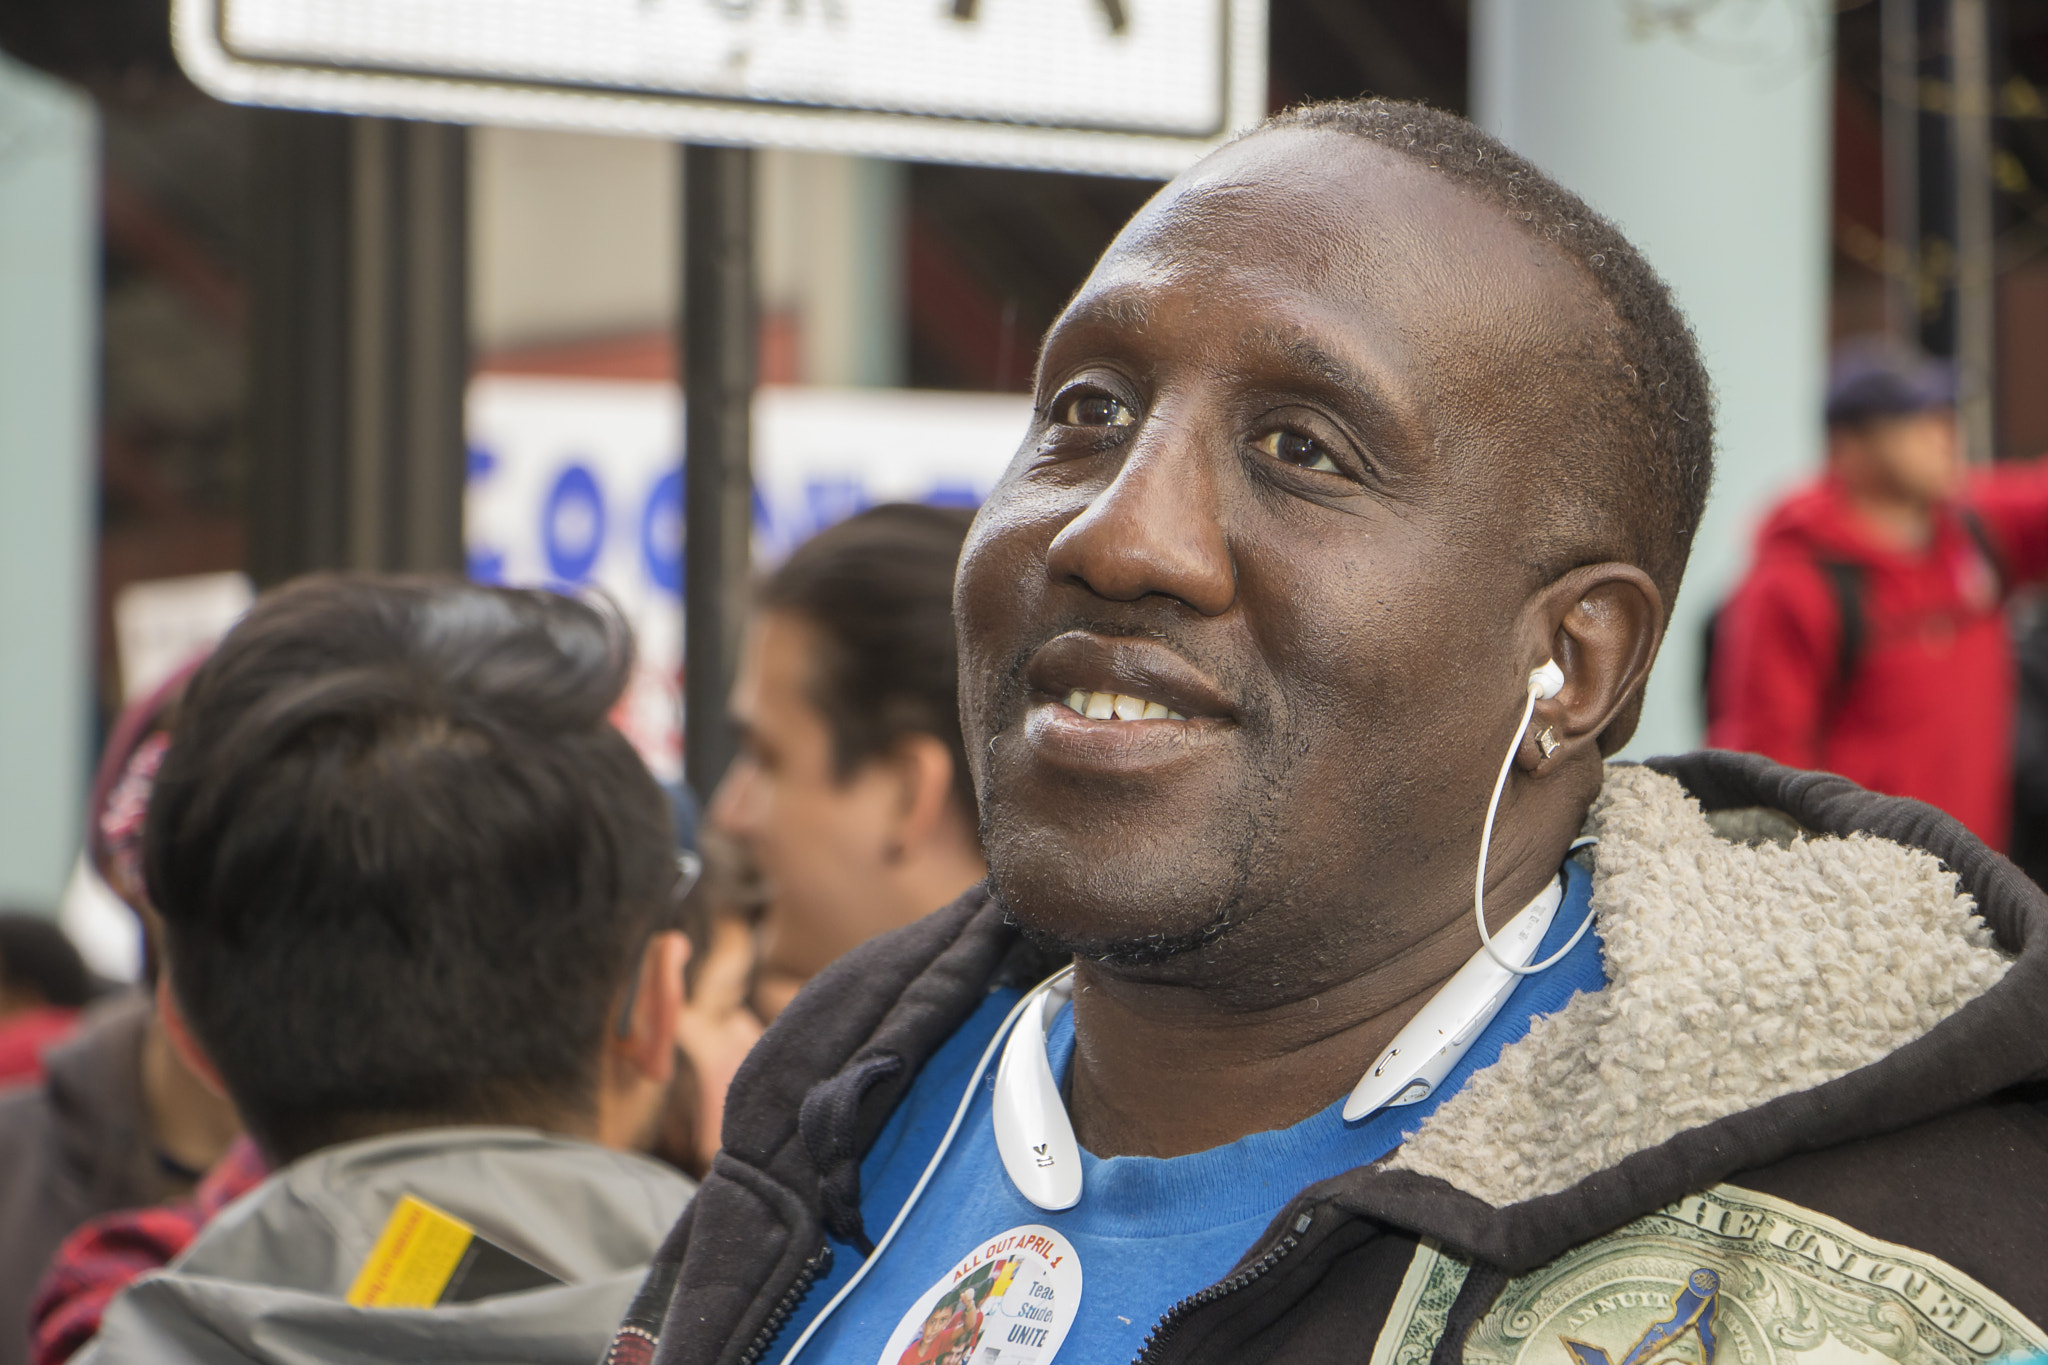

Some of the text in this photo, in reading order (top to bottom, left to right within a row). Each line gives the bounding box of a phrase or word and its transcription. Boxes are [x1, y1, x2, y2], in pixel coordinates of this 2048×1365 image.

[953, 1234, 1064, 1283] ALL OUT APRIL 1
[1668, 1192, 2002, 1356] HE UNITED
[1567, 1291, 1670, 1331] ANNUIT
[1007, 1324, 1050, 1348] UNITE
